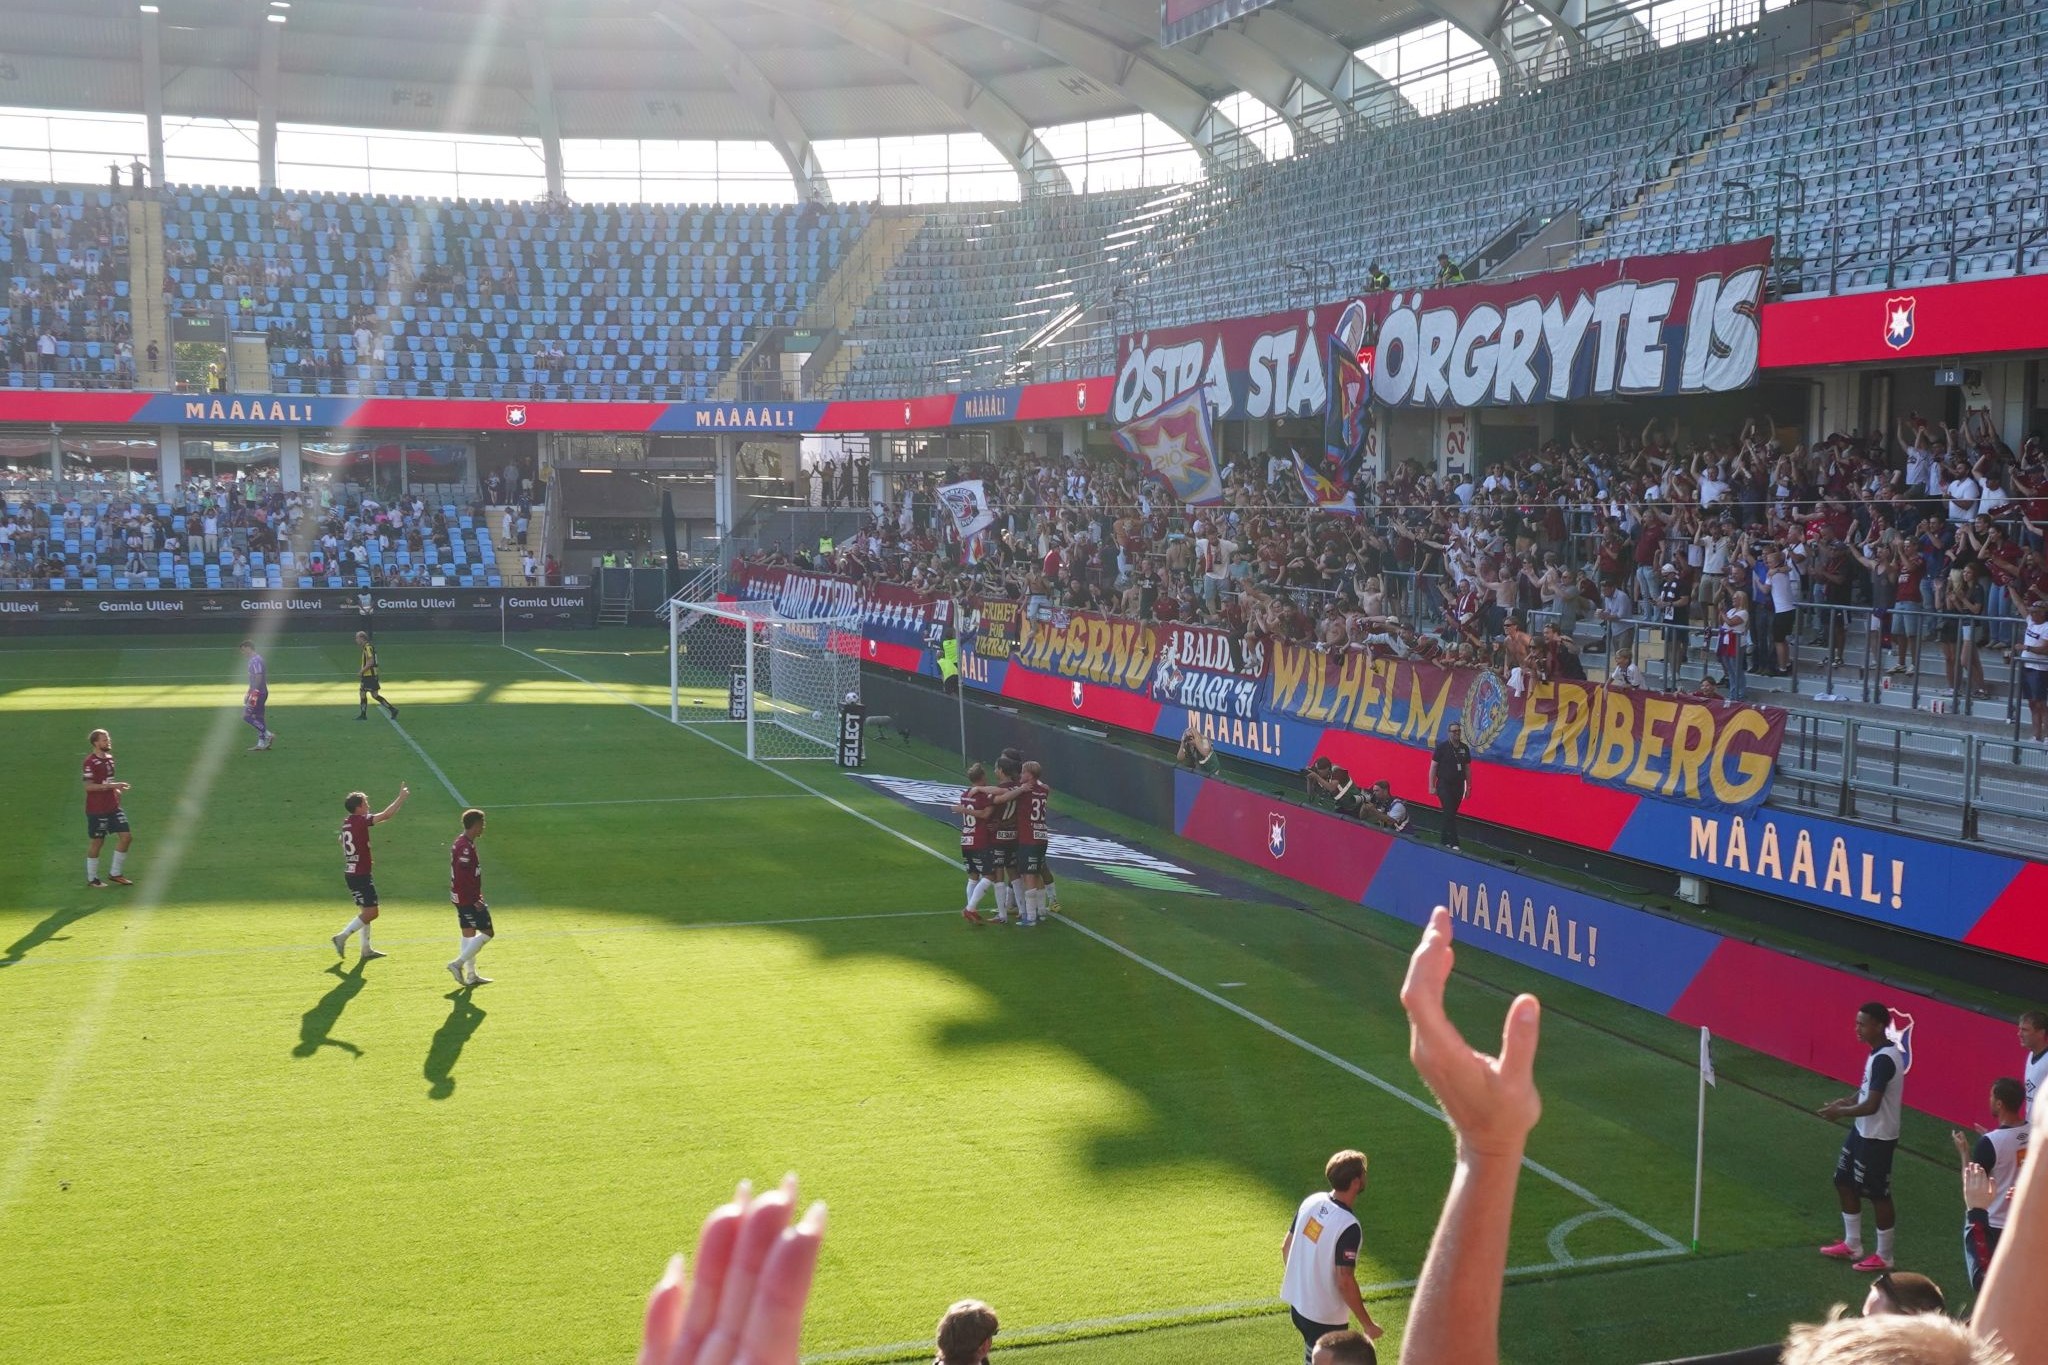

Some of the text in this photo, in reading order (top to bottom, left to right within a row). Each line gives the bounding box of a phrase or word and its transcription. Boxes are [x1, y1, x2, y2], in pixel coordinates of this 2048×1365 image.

[1247, 309, 1327, 417] STÅ
[1373, 281, 1678, 405] ÖRGRYTE
[1680, 266, 1766, 393] IS
[1944, 372, 1954, 382] 13
[185, 400, 312, 421] MÅÅÅÅL!
[696, 407, 794, 426] MÅÅÅÅL!
[965, 394, 1005, 418] MÅÅÅÅL!
[0, 602, 39, 613] Ullevi
[98, 600, 184, 612] Gamla Ullevi
[240, 599, 322, 610] Gamla Ullevi
[377, 598, 456, 609] Gamla Ullevi
[509, 597, 584, 608] Gamla Ullevi
[982, 602, 1018, 623] FRIHET
[732, 673, 746, 718] SELECT
[1180, 671, 1234, 713] HAGE
[1271, 639, 1454, 748] WILHELM
[844, 713, 860, 767] SELECT
[1511, 681, 1773, 804] FRIBERG
[1689, 815, 1905, 910] MÅÅÅÅL!
[1449, 880, 1598, 967] MÅÅÅÅL!
